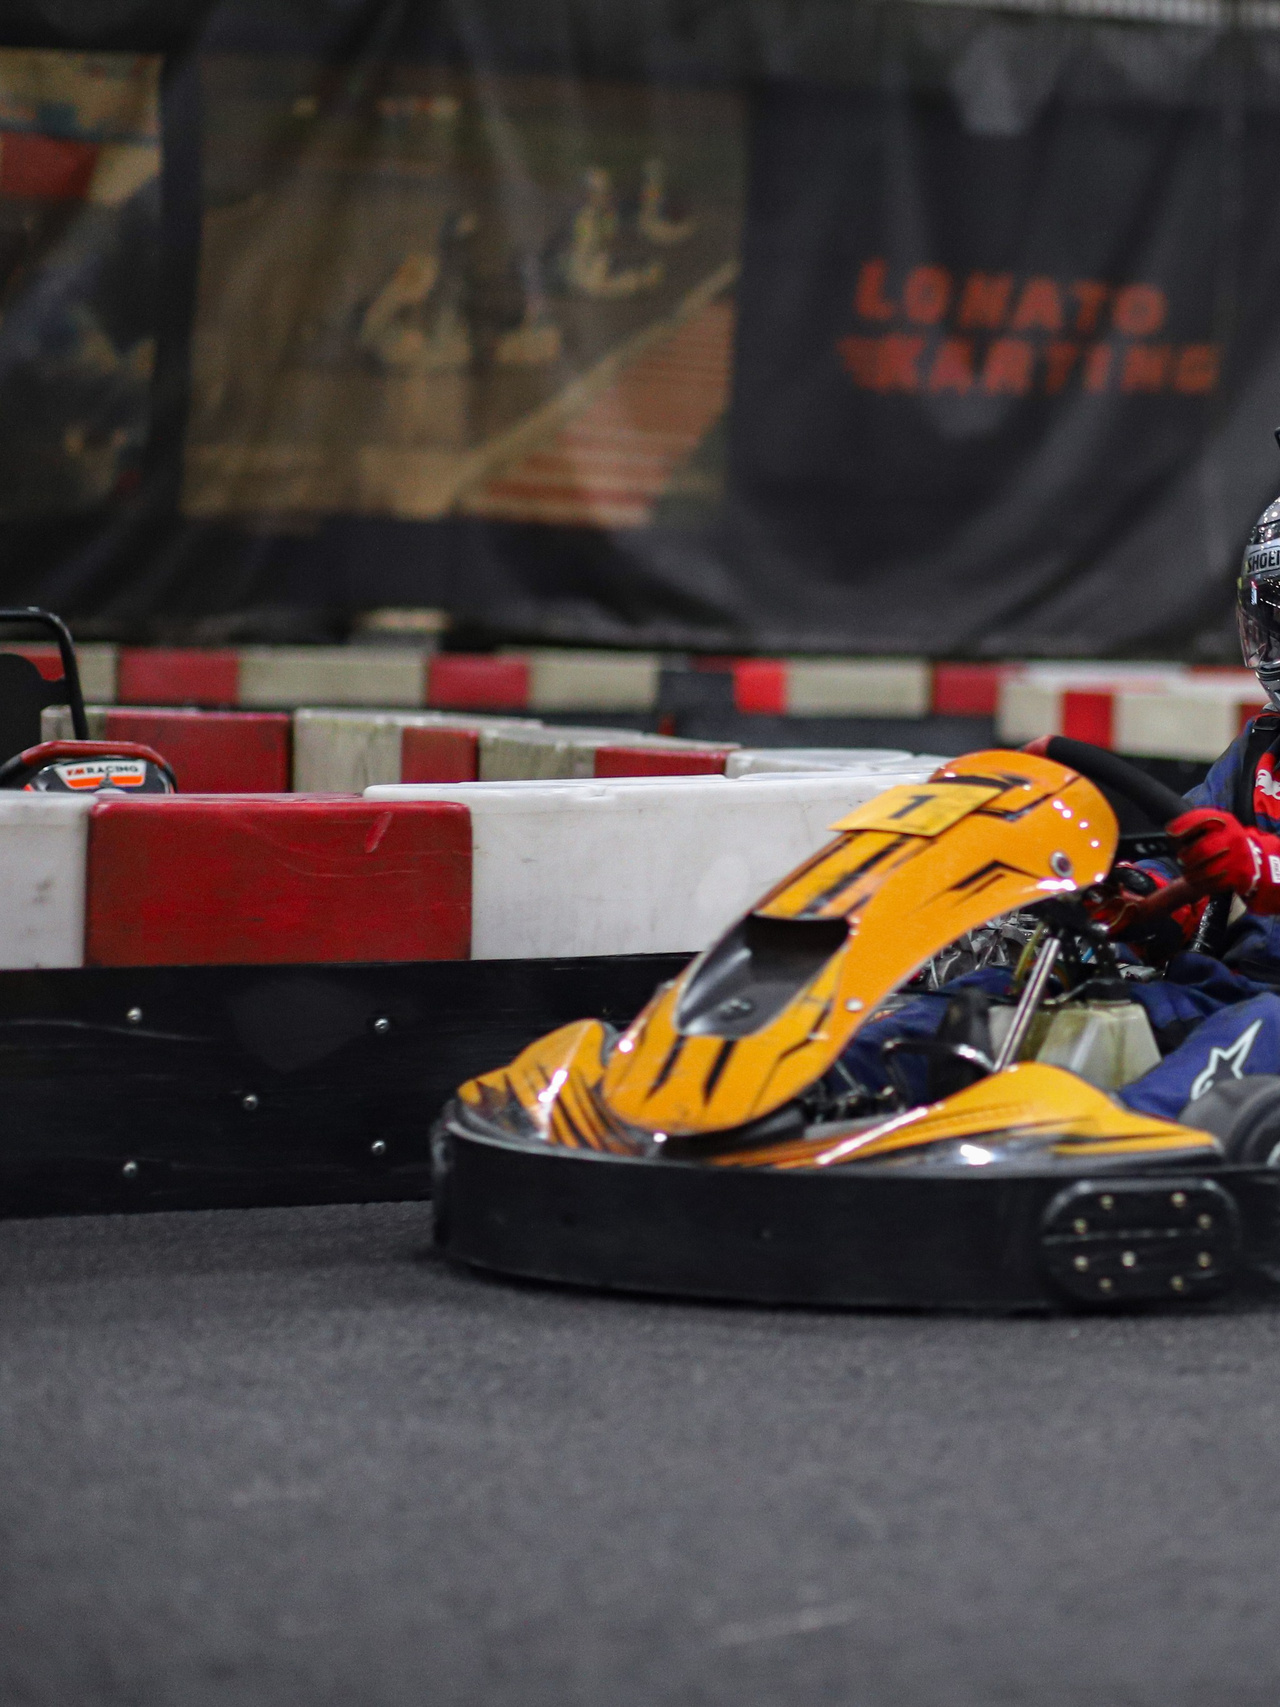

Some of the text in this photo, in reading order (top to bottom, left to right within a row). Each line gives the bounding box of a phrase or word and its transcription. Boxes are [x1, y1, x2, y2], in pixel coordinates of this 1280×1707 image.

[855, 258, 1167, 337] LONATO
[874, 334, 1222, 394] KARTING
[1248, 550, 1280, 573] SHOEI
[87, 764, 138, 773] RACING
[888, 795, 936, 818] 1
